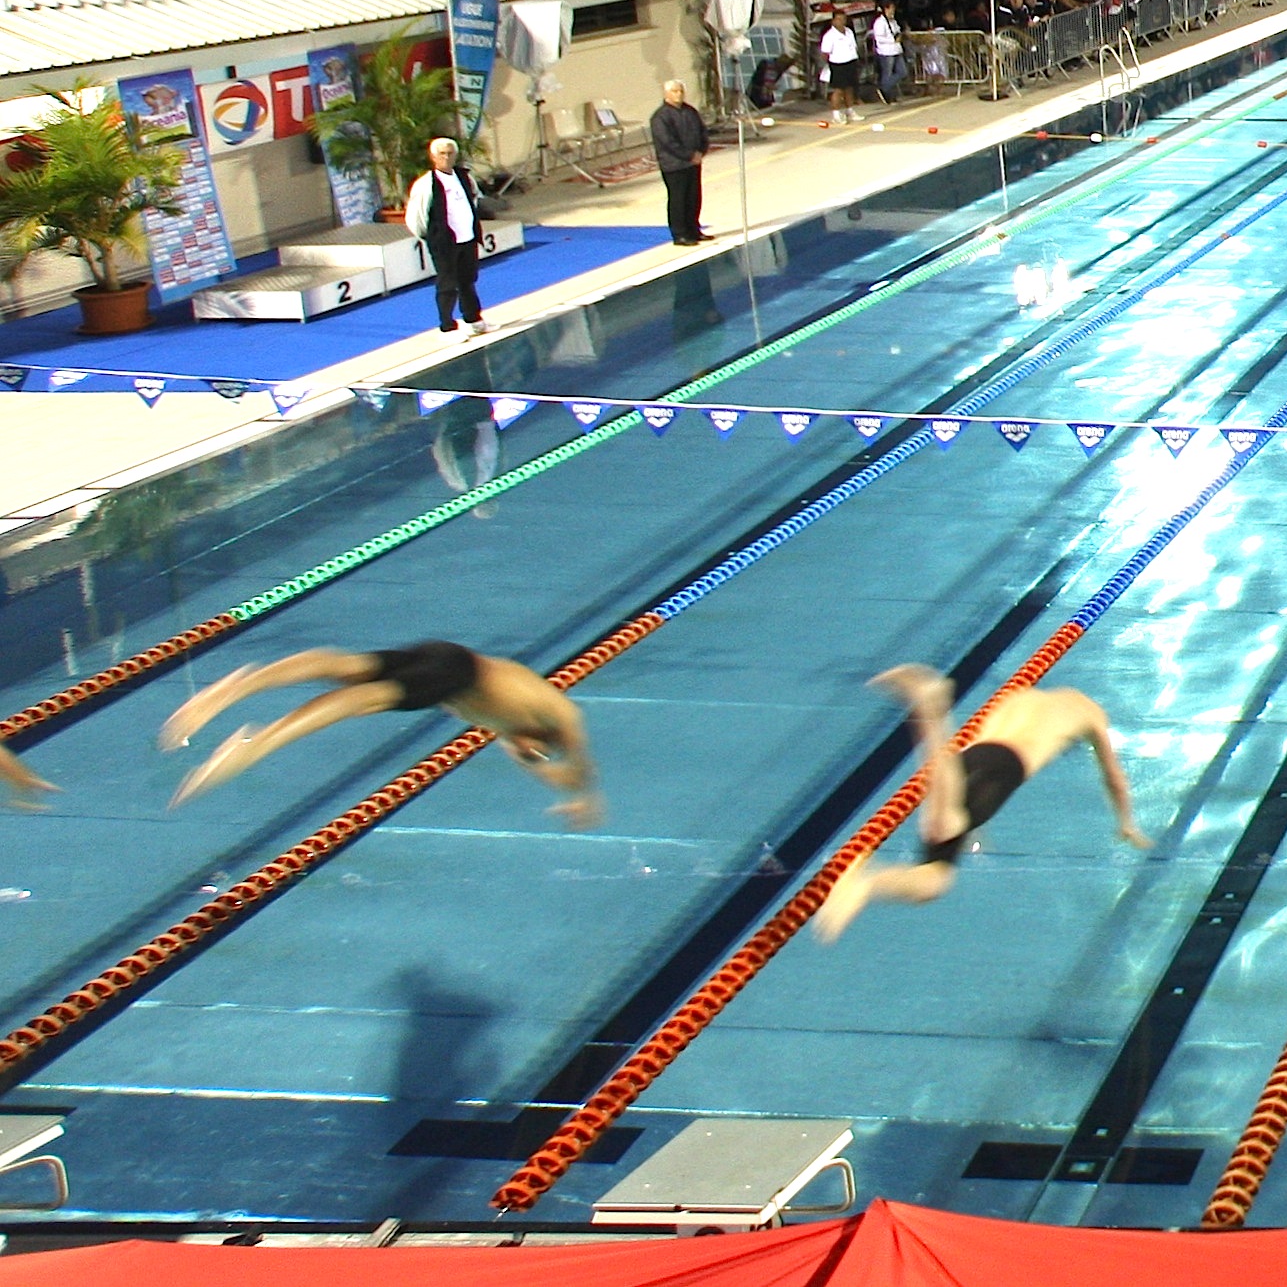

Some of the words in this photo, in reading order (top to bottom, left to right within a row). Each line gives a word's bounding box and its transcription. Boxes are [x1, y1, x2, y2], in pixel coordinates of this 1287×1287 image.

[484, 233, 497, 254] 3
[413, 240, 426, 271] 1
[337, 280, 352, 304] 2
[1001, 423, 1031, 434] arena
[1077, 426, 1106, 437] arena
[1161, 429, 1190, 440] arena
